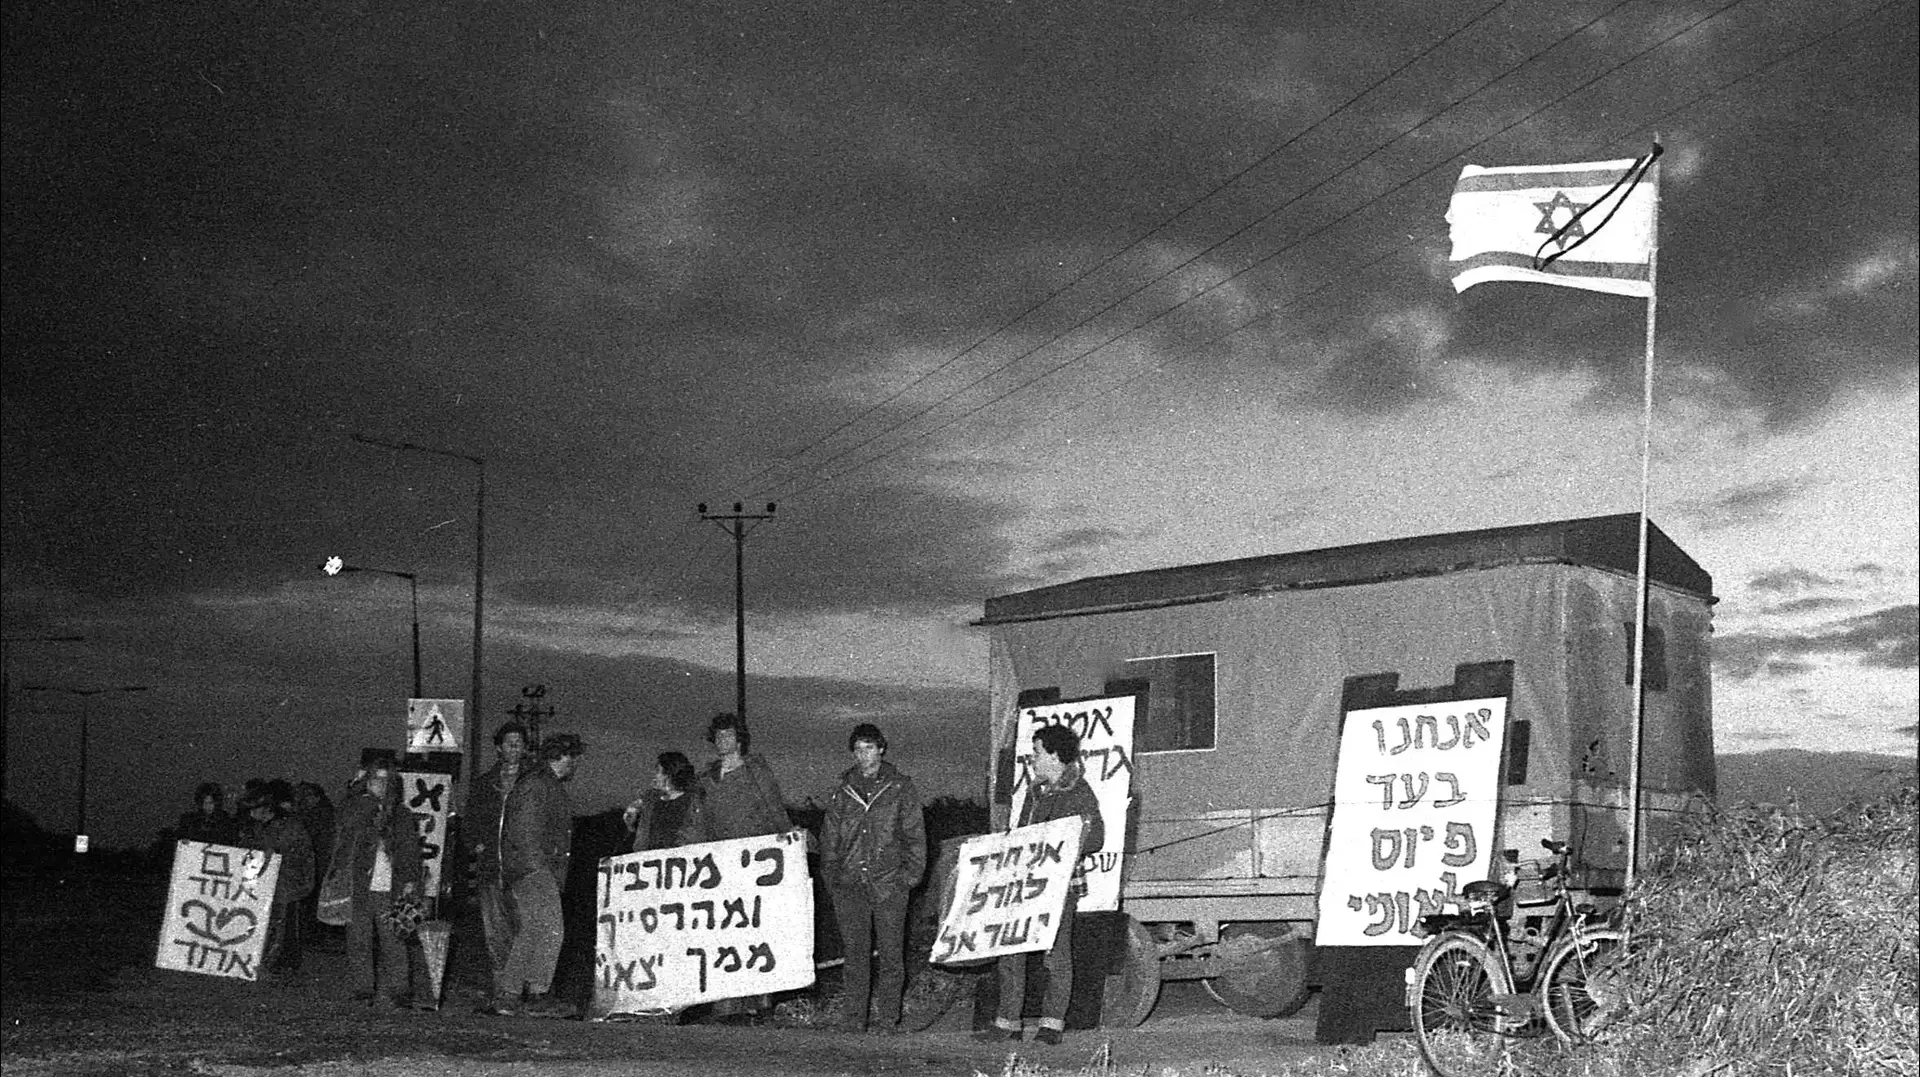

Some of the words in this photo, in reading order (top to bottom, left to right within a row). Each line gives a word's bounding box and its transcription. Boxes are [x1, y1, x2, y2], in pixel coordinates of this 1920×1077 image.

[1371, 708, 1491, 755] אנחנו
[1366, 771, 1468, 810] בעד
[970, 846, 1023, 875] חרד
[1026, 840, 1065, 868] אני
[1370, 821, 1477, 871] פיוס
[967, 873, 1048, 915] לגורל
[173, 939, 254, 978] אחד
[686, 942, 776, 993] ממך
